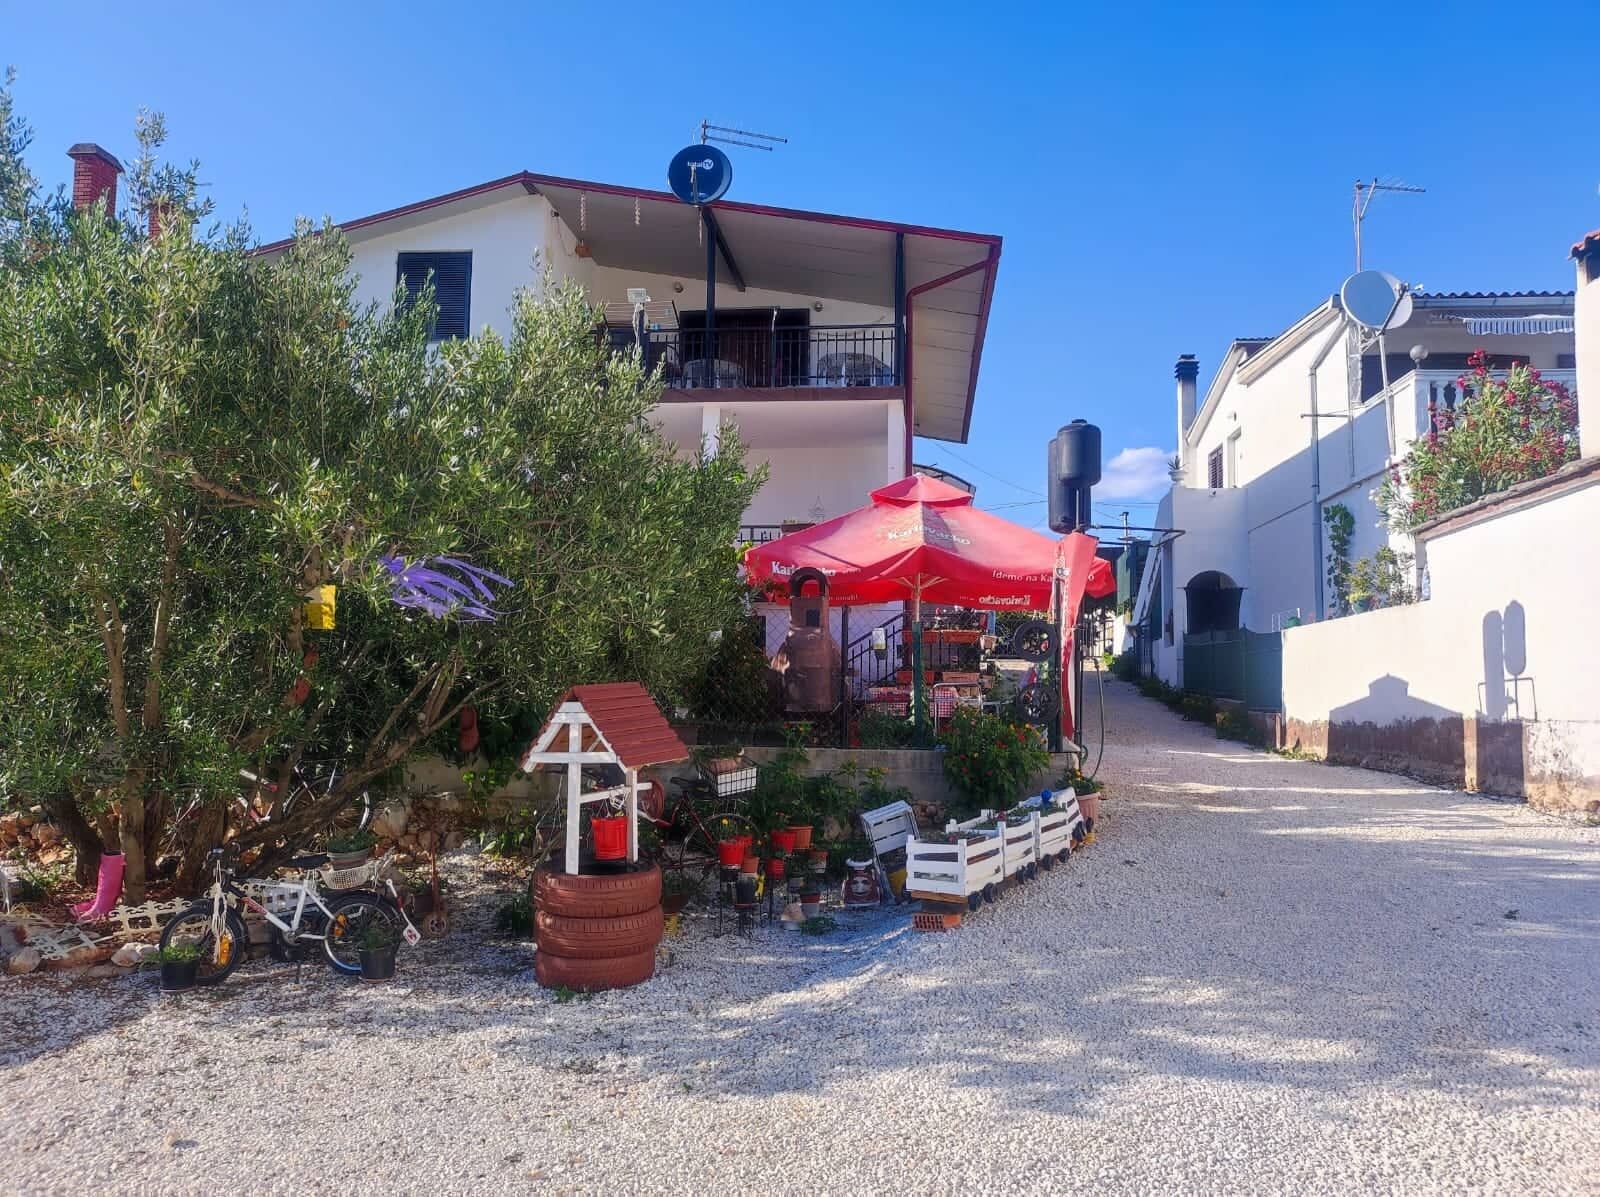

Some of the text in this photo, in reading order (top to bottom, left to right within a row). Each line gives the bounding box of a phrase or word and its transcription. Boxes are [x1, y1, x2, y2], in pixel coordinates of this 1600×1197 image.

[771, 561, 836, 577] Karlko
[992, 570, 1023, 581] Idemo
[1025, 574, 1037, 582] na
